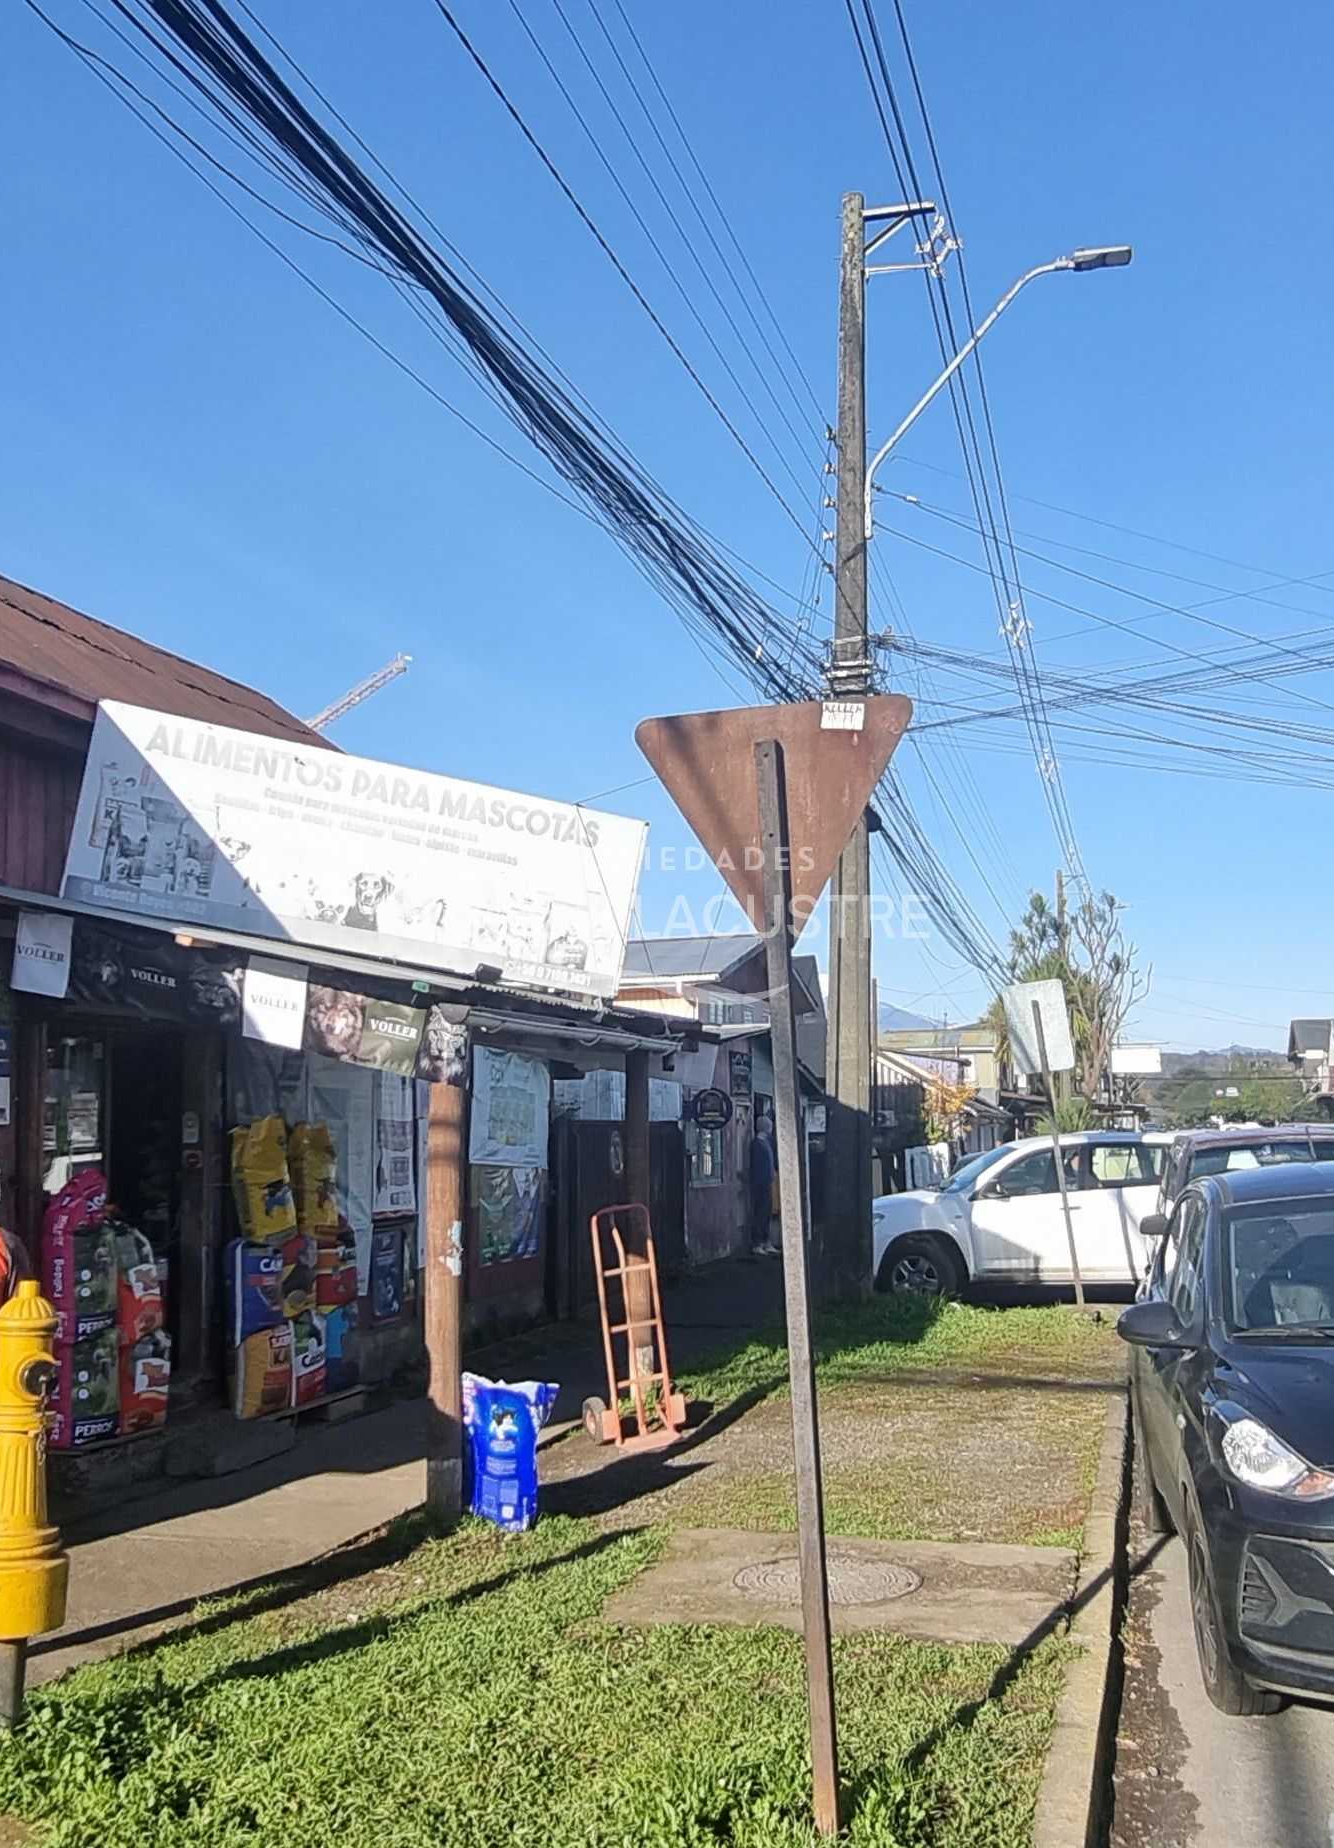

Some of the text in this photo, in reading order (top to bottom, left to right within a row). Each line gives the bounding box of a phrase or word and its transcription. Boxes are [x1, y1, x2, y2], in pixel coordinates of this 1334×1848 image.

[145, 721, 600, 848] ALIMENTOS PARA MASCOTAS
[17, 944, 65, 963] VOLLER
[130, 968, 177, 989] VOLLER
[369, 1017, 418, 1040] VOLLER
